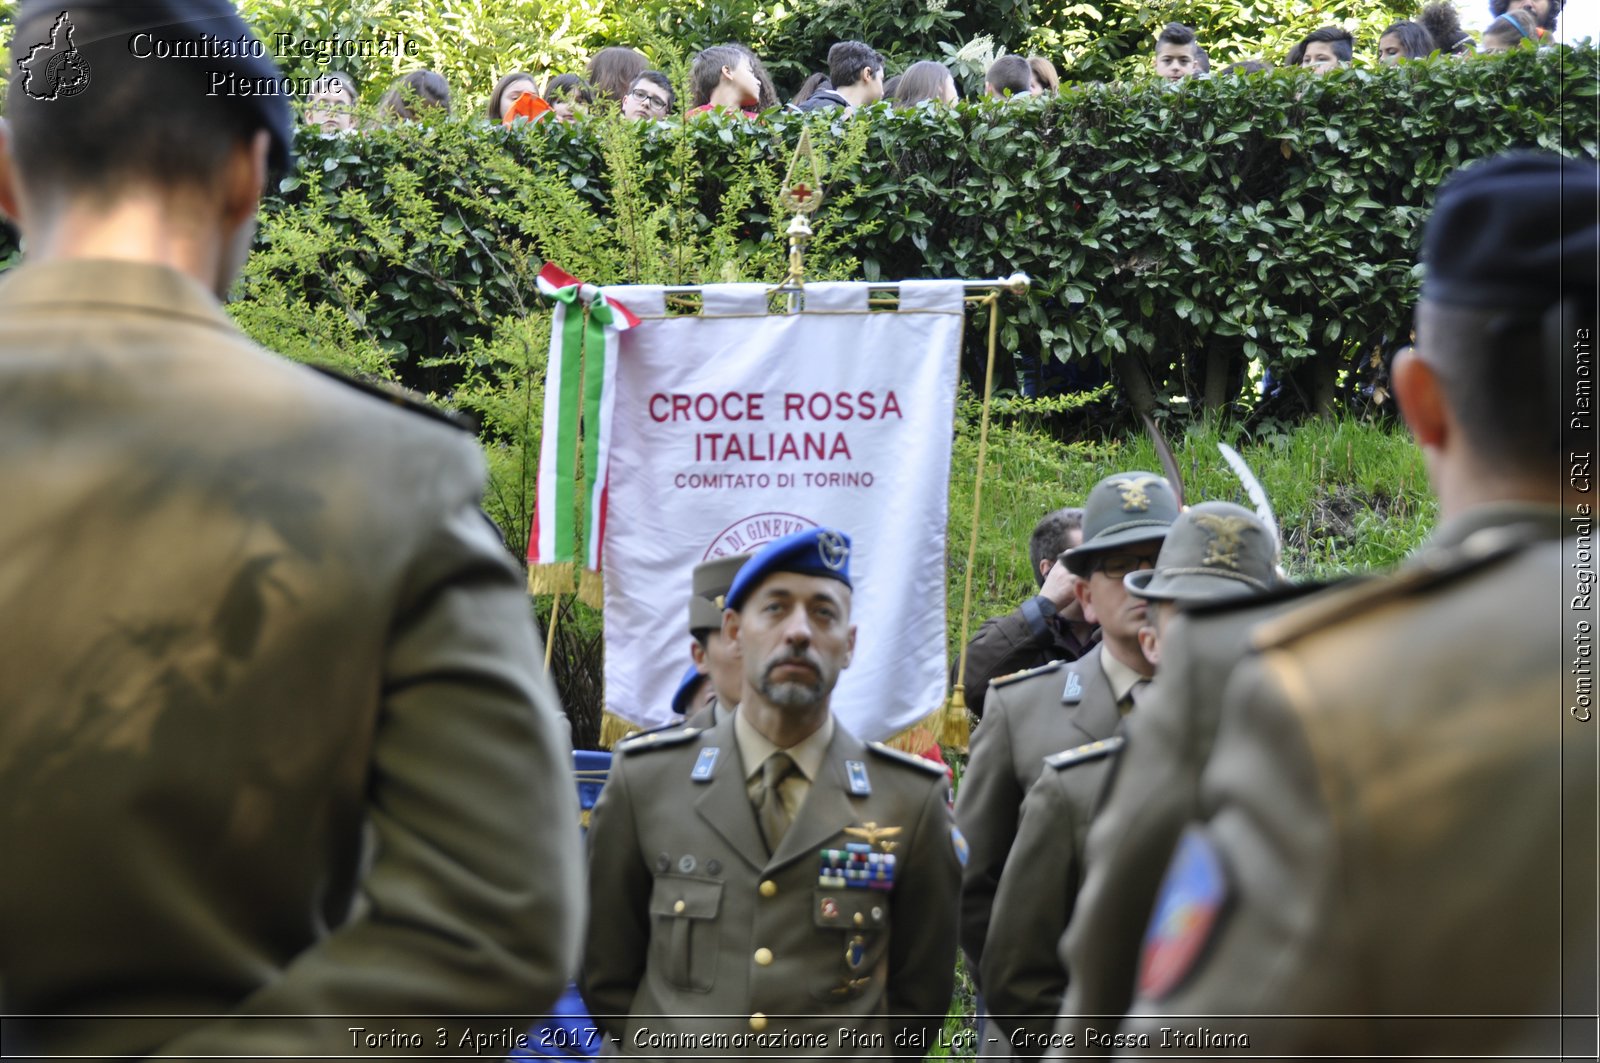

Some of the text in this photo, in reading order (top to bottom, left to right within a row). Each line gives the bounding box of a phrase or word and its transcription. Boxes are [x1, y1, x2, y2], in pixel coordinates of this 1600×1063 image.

[648, 390, 903, 423] CROCE ROSSA
[695, 432, 852, 461] ITALIANA
[674, 472, 874, 489] COMITATO DI TORINO
[725, 531, 746, 551] DI
